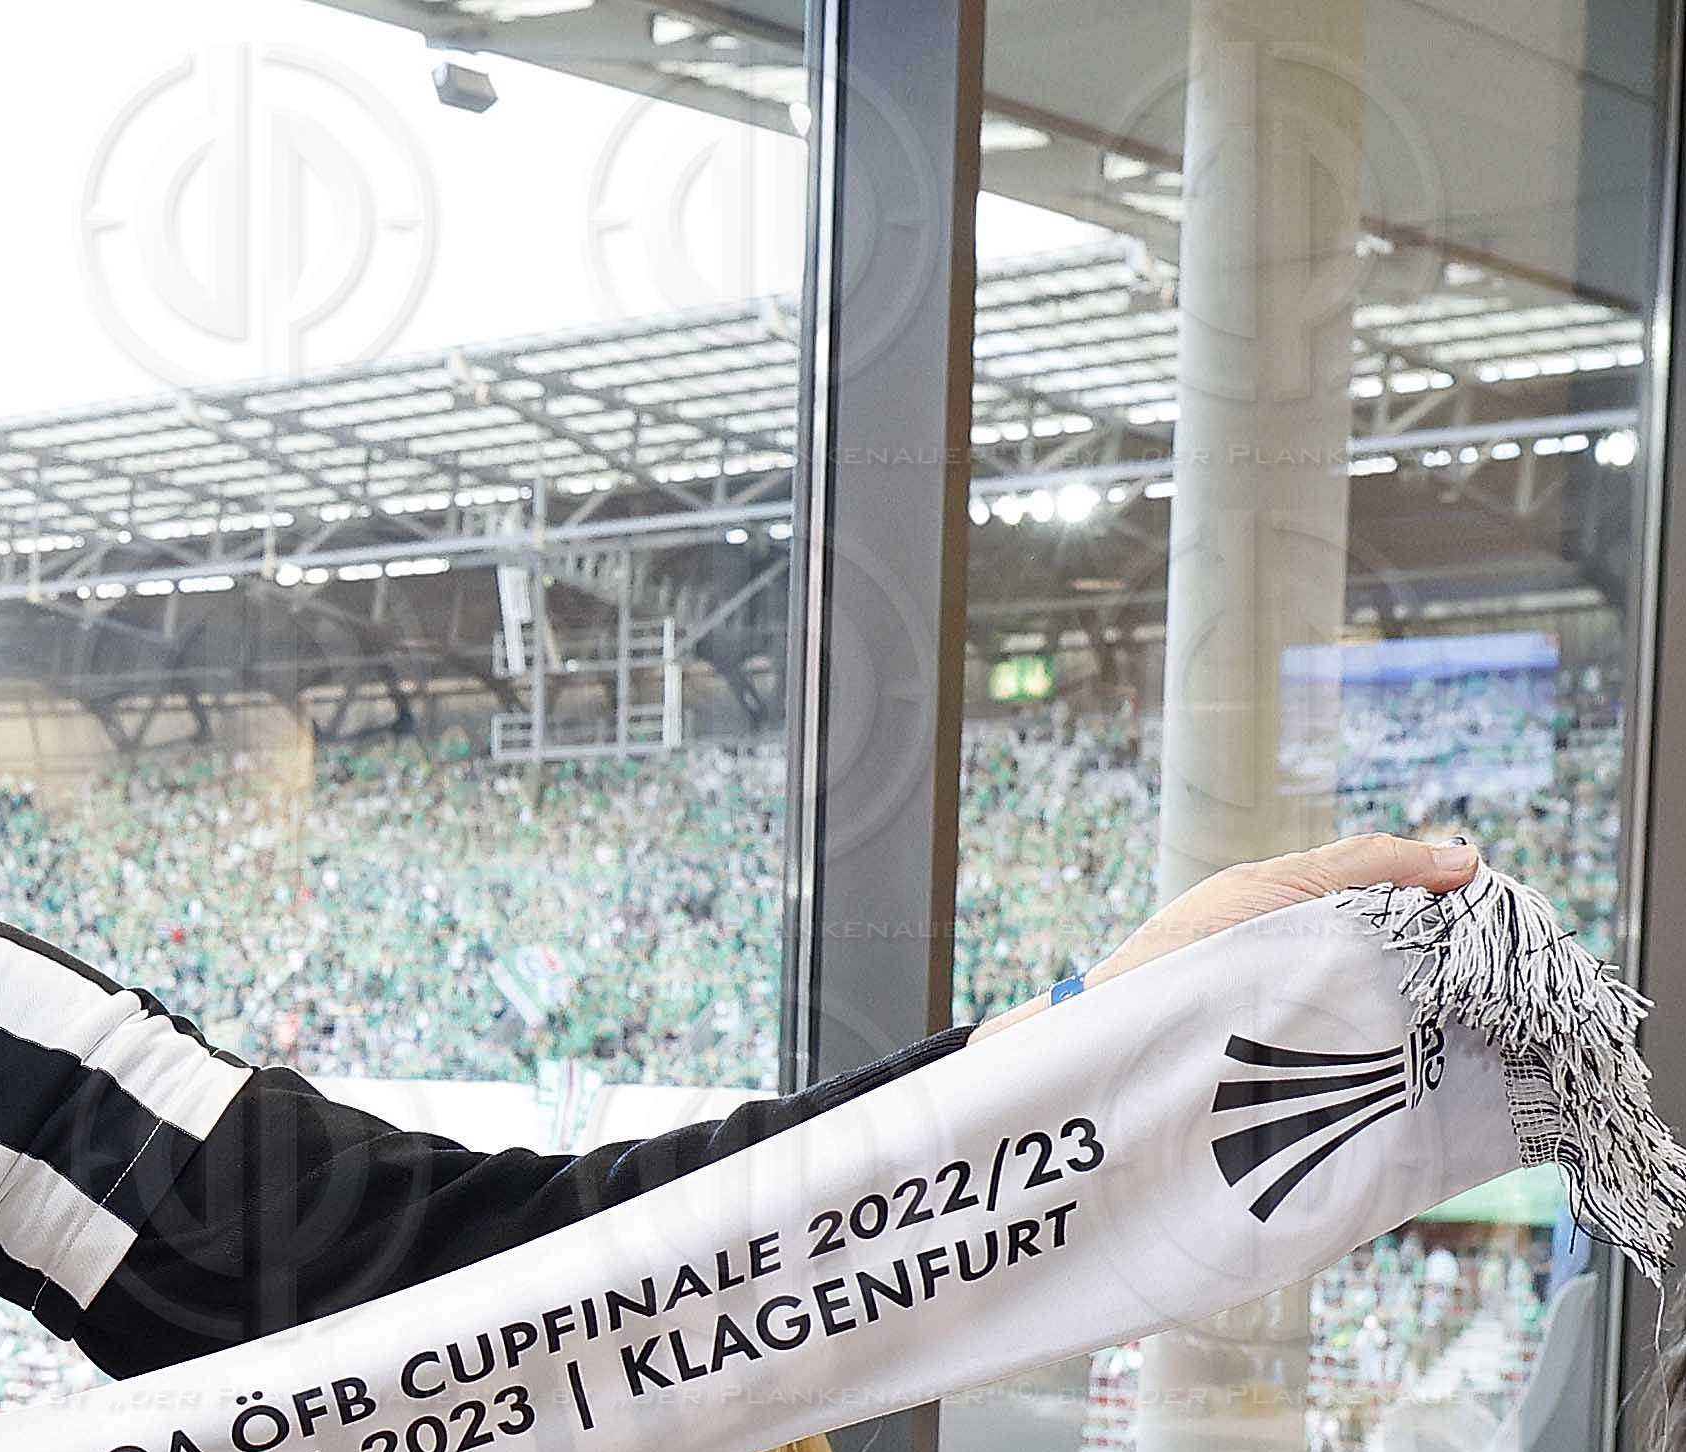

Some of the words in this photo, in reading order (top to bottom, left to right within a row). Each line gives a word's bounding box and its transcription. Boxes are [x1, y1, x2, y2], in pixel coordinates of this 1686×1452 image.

[400, 1230, 783, 1400] CUPFINALE
[808, 1116, 1106, 1260] 2022/23
[620, 1201, 1079, 1398] KLAGENFURT
